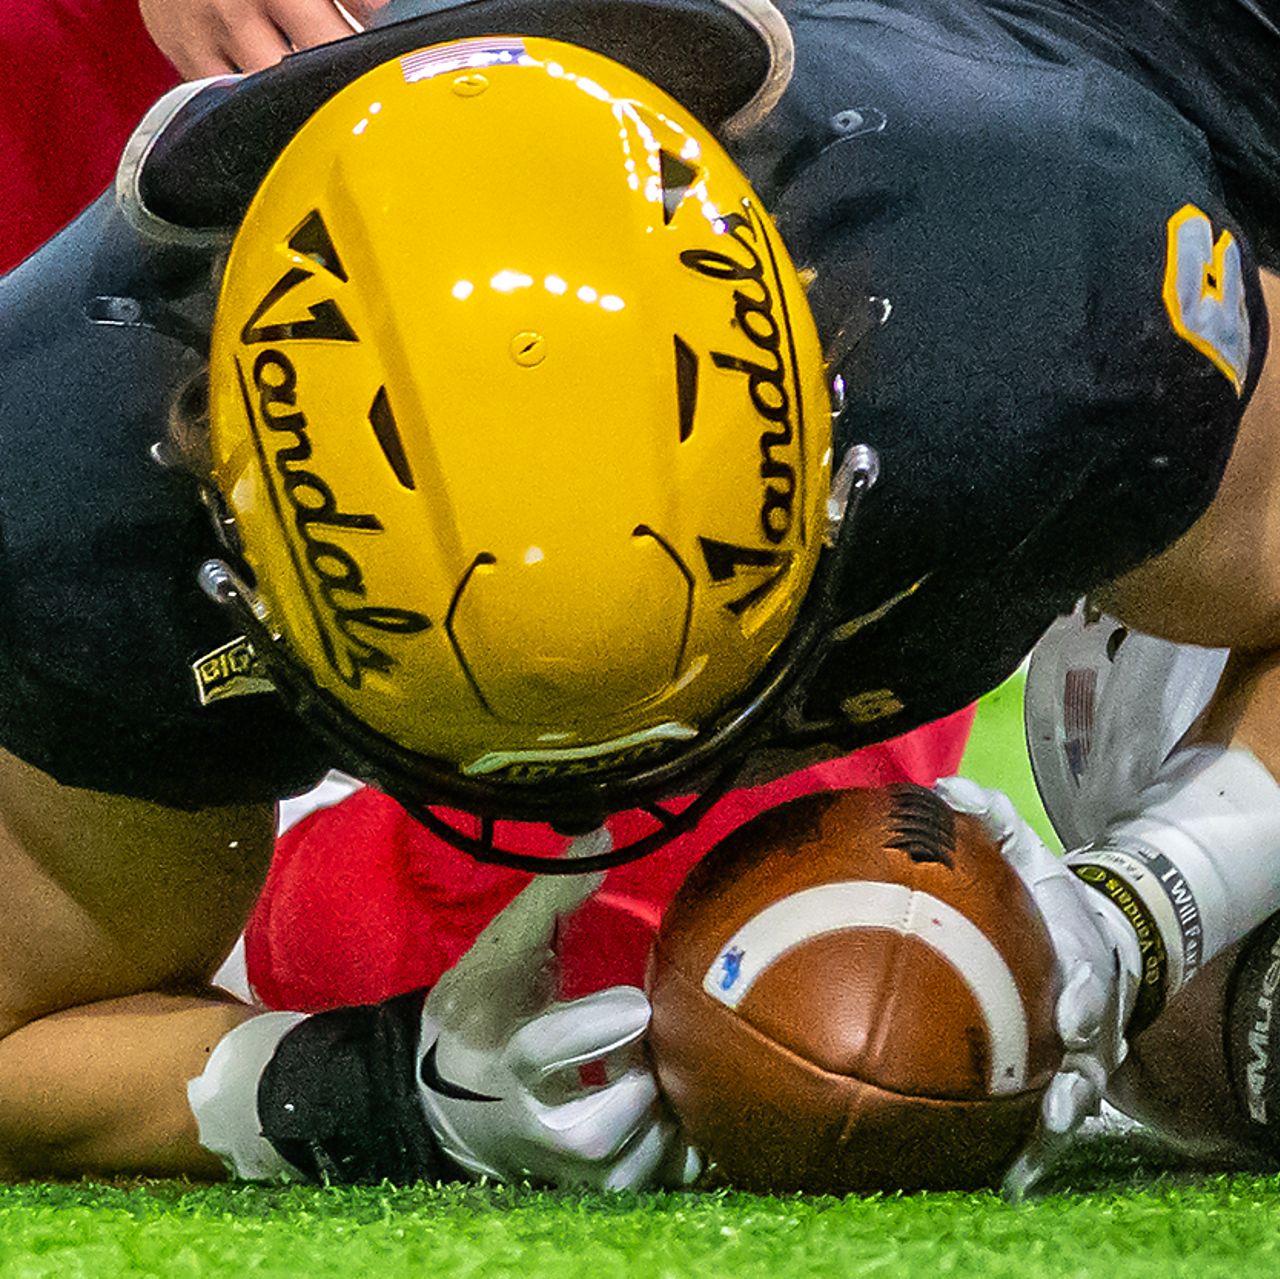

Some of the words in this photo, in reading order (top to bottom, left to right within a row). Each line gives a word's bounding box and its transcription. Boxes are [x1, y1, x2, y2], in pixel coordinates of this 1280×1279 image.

[236, 266, 433, 689] Vandals
[680, 205, 802, 616] Vandals
[1105, 877, 1154, 953] Vandals
